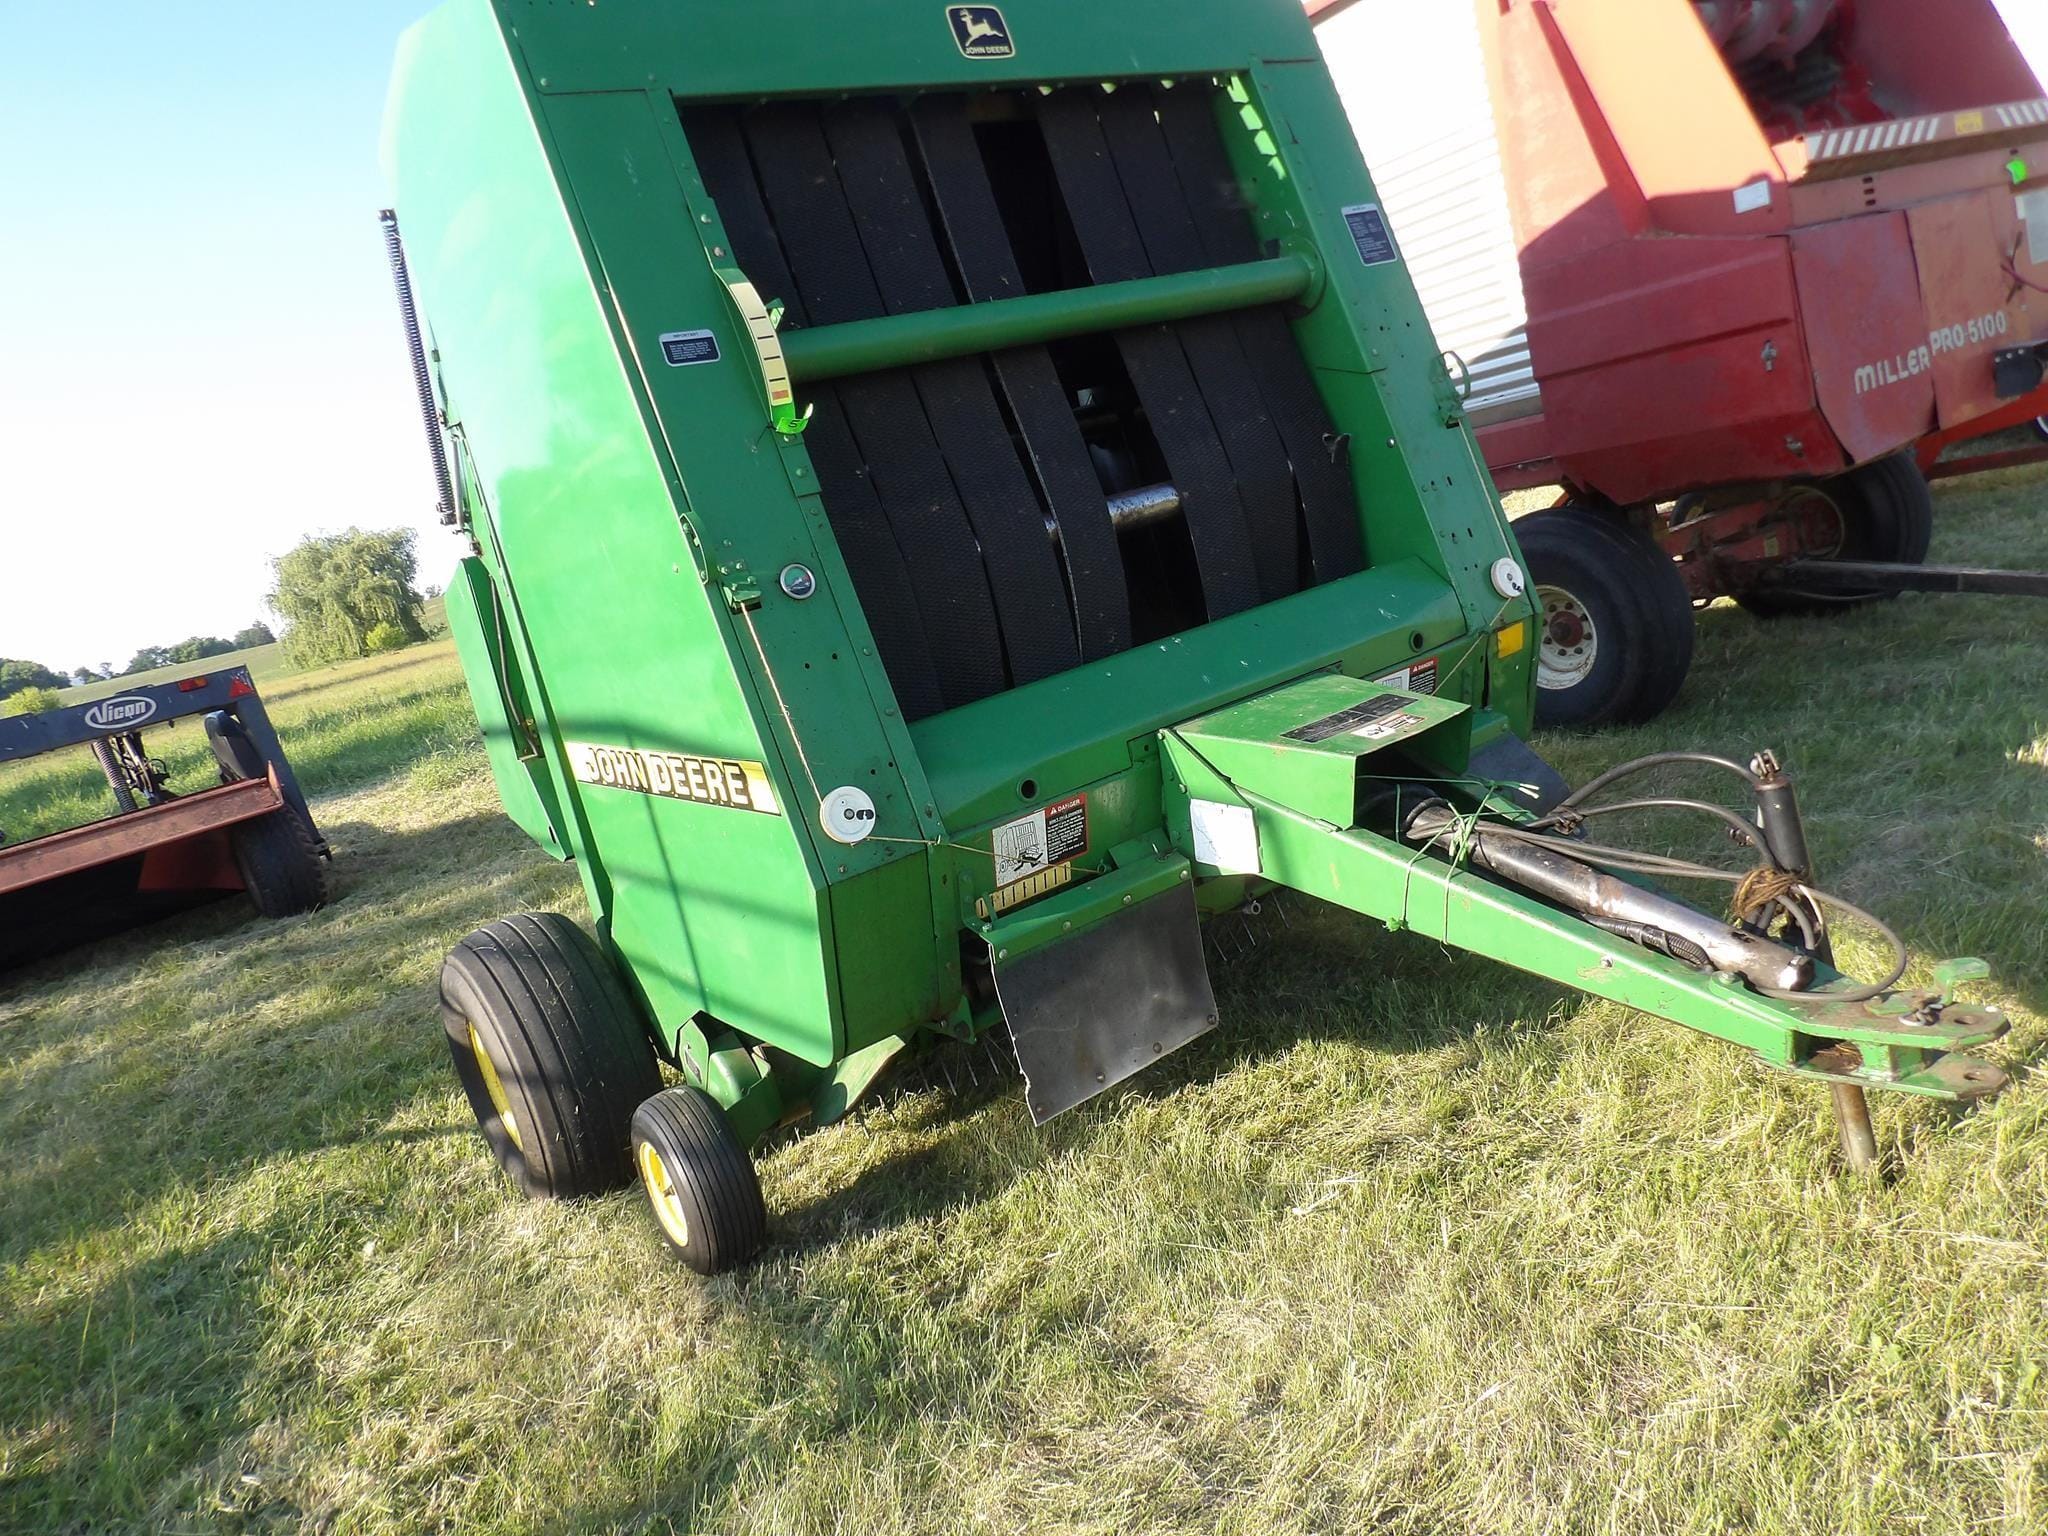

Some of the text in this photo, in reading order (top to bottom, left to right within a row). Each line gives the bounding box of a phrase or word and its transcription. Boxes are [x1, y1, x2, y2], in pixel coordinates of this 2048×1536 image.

[986, 46, 1010, 54] DEERE
[1854, 345, 1930, 394] MILLER
[93, 701, 146, 723] Vicon
[584, 747, 750, 806] JOHN DEERE
[1057, 798, 1080, 812] DANGER
